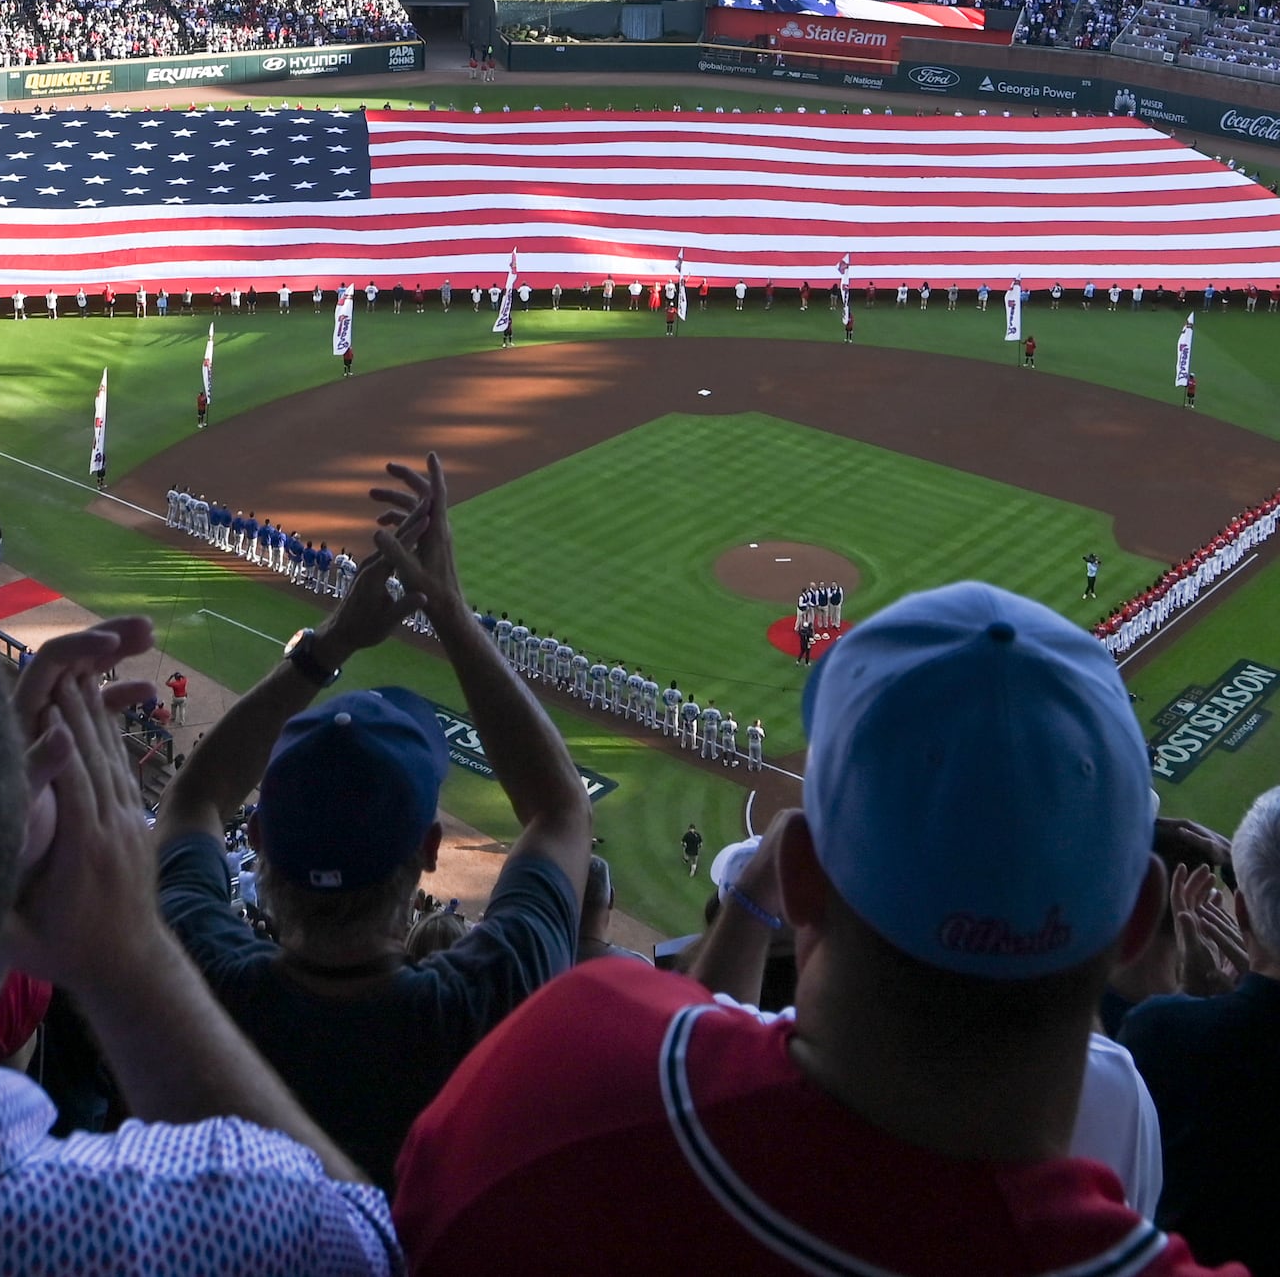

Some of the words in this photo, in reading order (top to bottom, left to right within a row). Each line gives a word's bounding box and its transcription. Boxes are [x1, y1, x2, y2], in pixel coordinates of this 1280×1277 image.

[389, 45, 415, 58] PAPA
[289, 53, 352, 69] HYUNDAI
[388, 55, 415, 66] JOHNS
[25, 69, 113, 90] QUIKRETE
[146, 64, 225, 85] EQUIFAX
[852, 75, 884, 87] National
[917, 69, 951, 85] Ford
[997, 81, 1041, 98] Georgia
[1041, 85, 1077, 100] Power
[1140, 98, 1164, 109] KAISER
[1140, 108, 1187, 124] PERMANENTE
[1153, 664, 1278, 778] POSTSEASON
